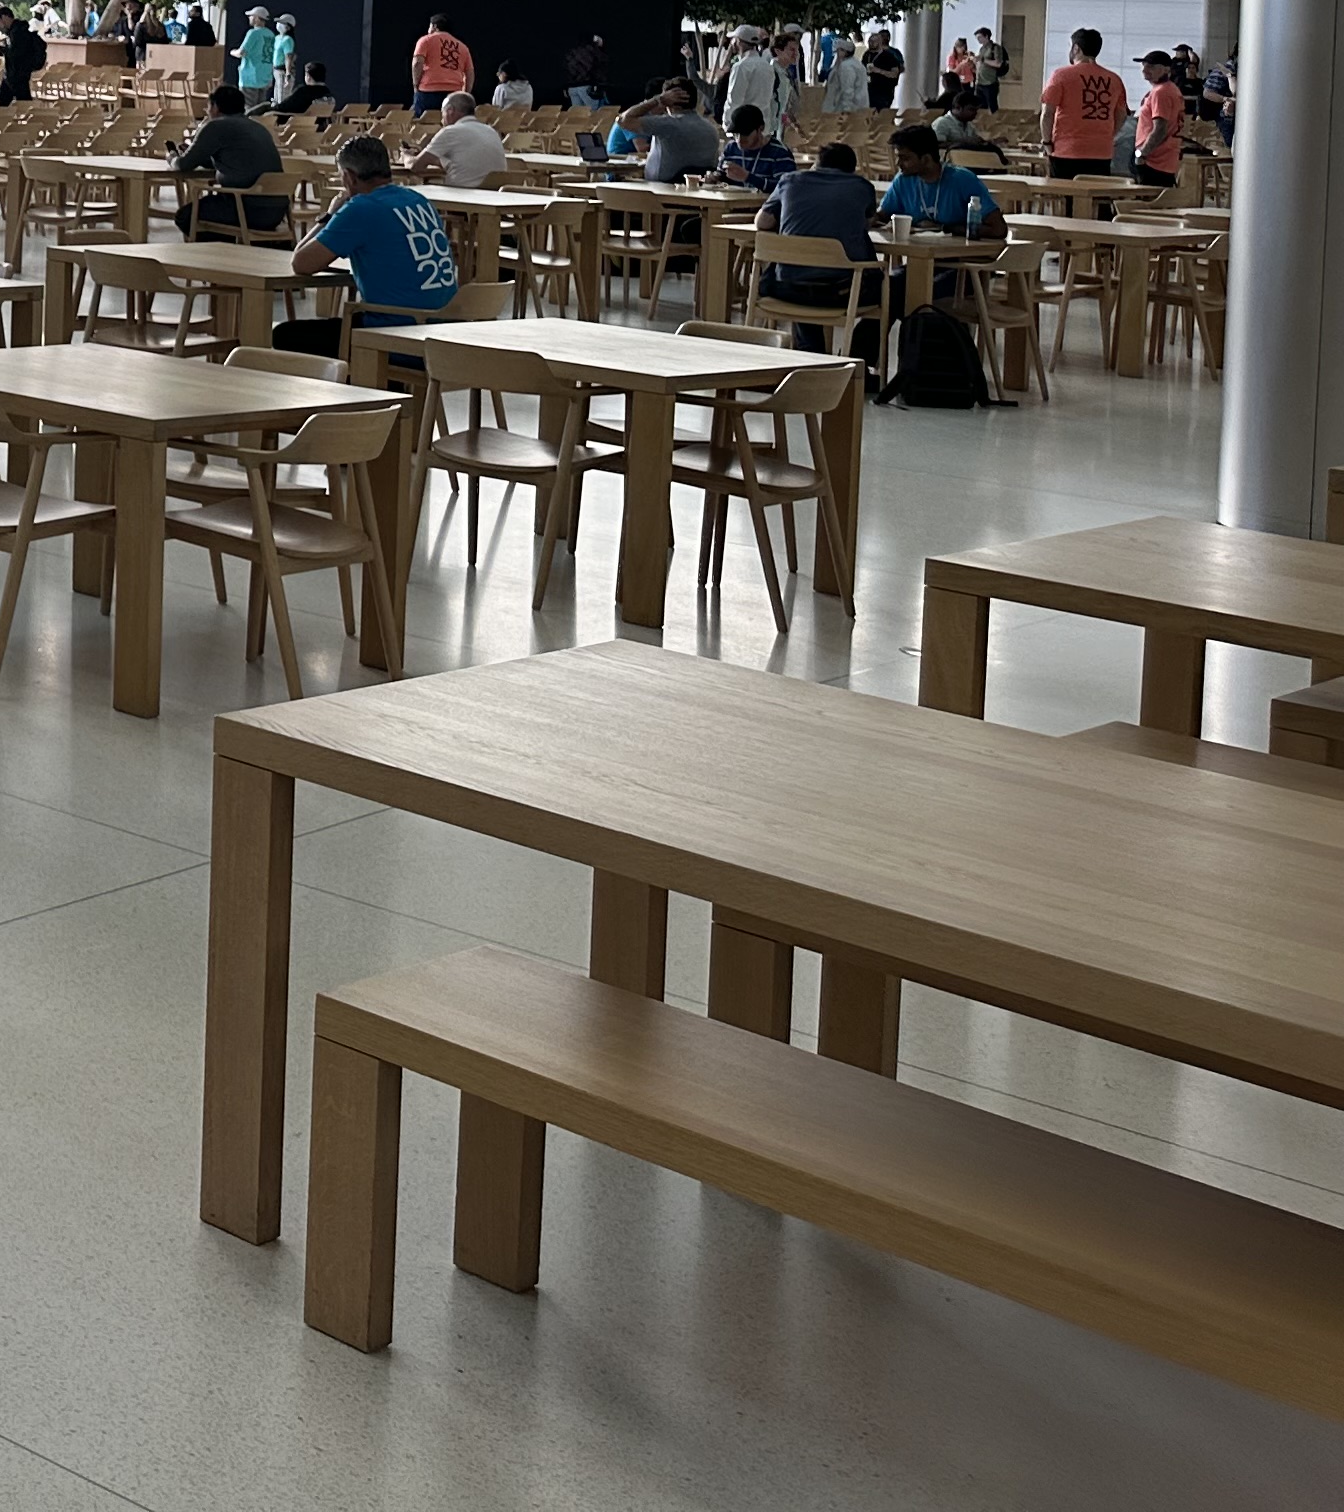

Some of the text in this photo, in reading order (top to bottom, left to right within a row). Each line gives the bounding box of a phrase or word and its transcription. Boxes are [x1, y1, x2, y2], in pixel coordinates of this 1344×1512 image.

[1082, 89, 1112, 106] DC
[1081, 104, 1110, 121] 23
[416, 256, 455, 291] 23
